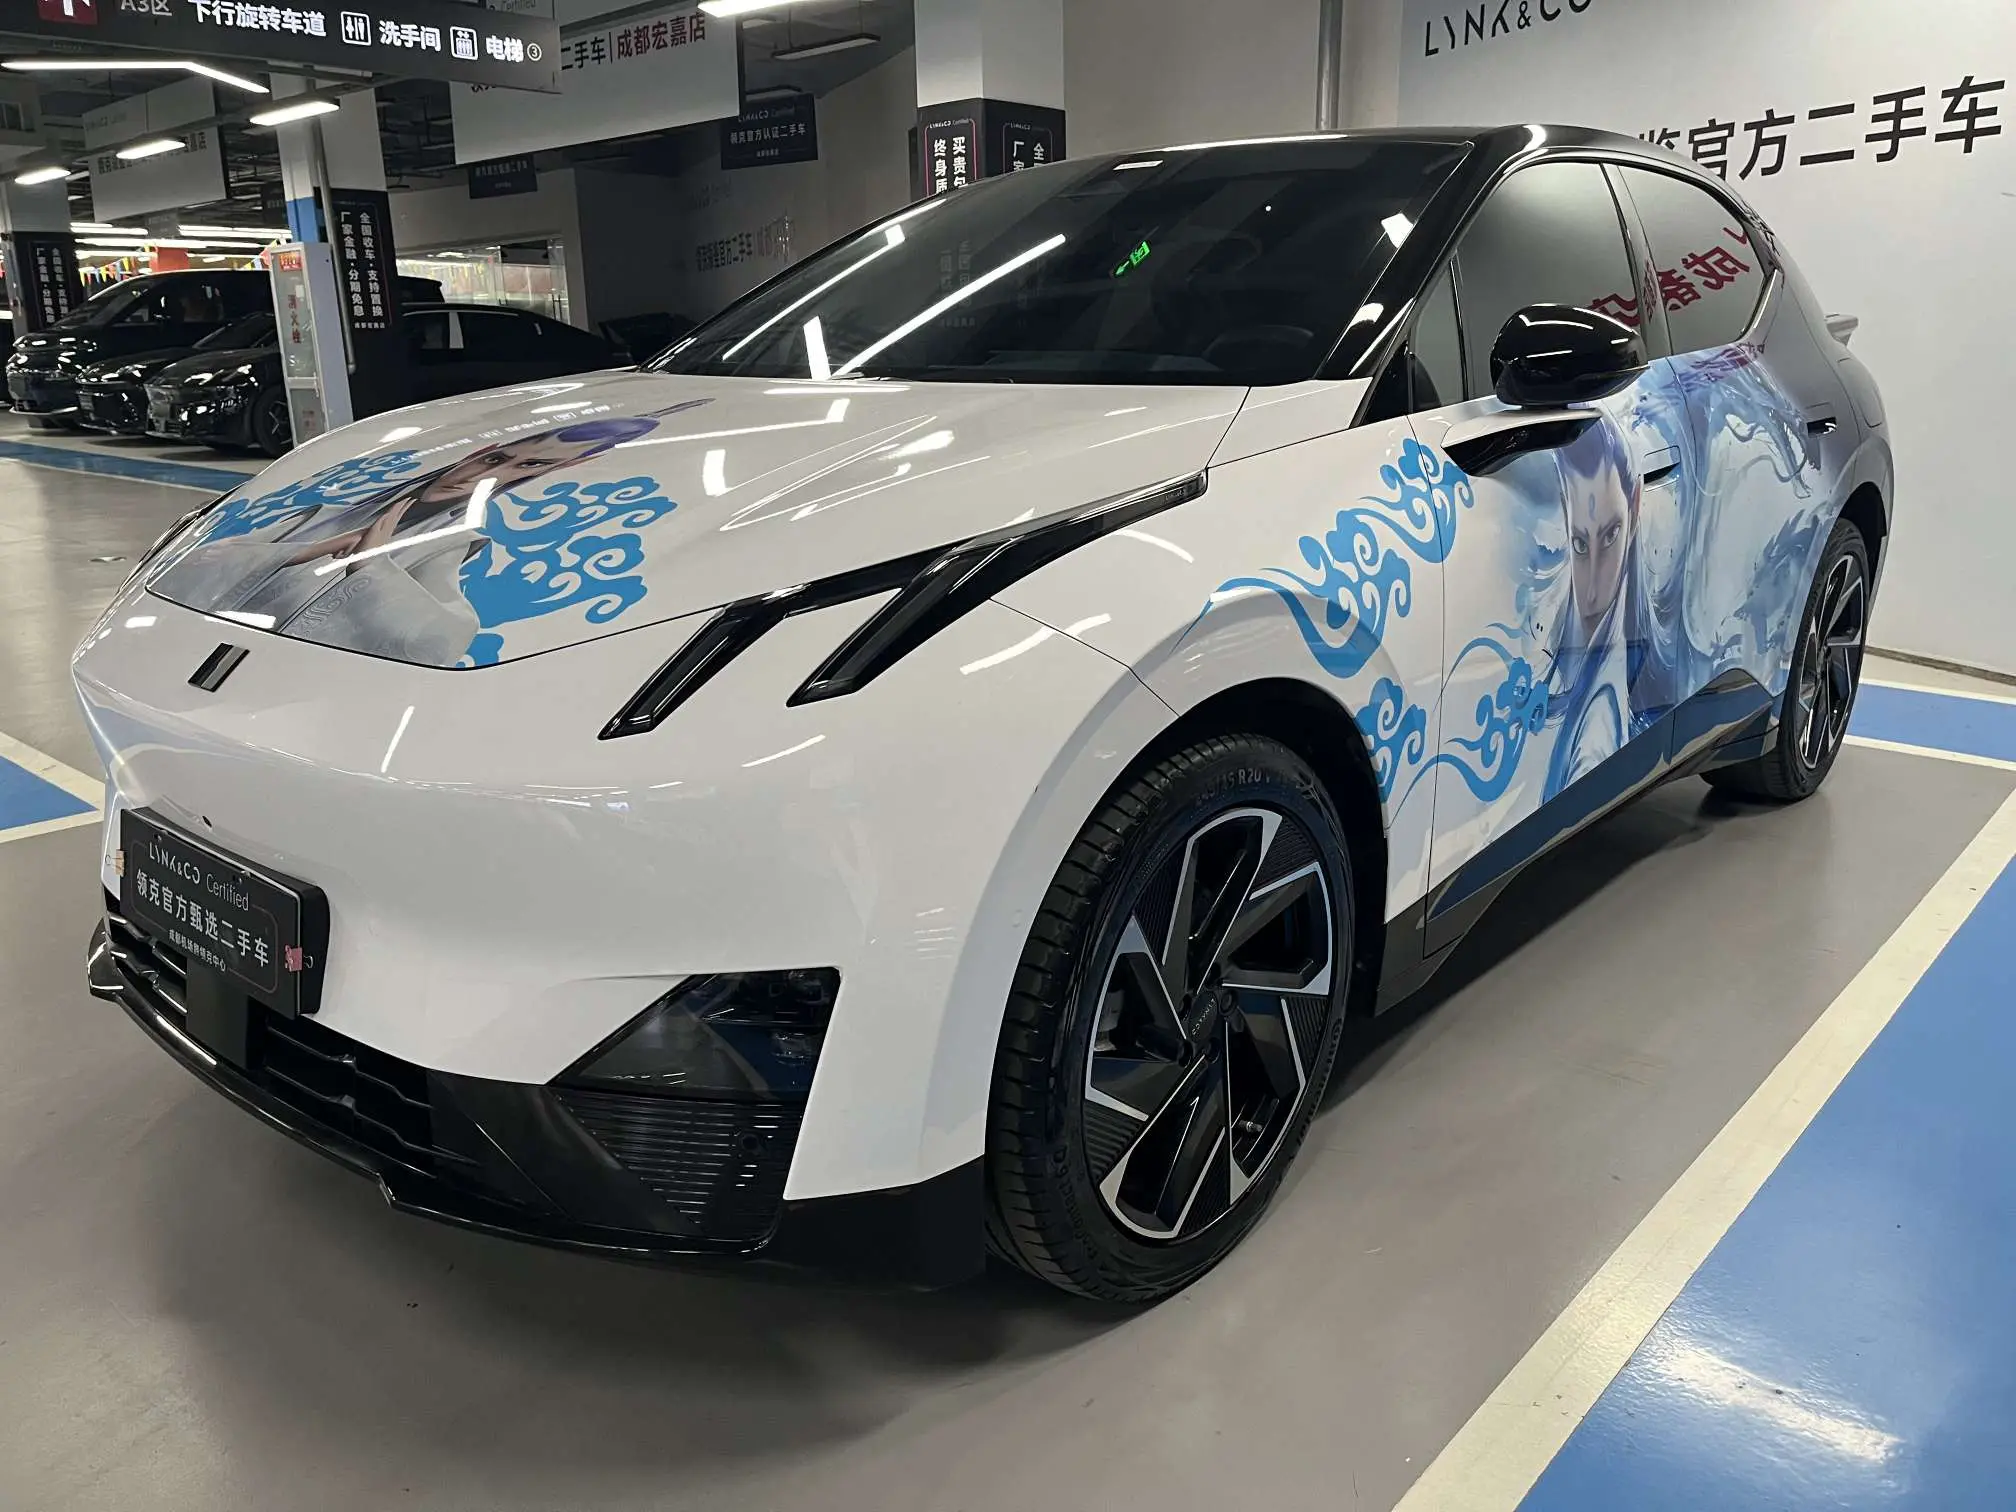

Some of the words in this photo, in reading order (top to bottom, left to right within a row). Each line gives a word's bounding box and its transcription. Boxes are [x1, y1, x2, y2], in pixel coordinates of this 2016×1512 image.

[187, 0, 327, 36] 下行旋转车道
[379, 19, 442, 52] 洗手间
[486, 35, 525, 63] 电梯
[149, 842, 200, 884] LYNK&CO
[206, 873, 249, 911] Certified
[136, 868, 269, 967] 领克官方甄选二手车
